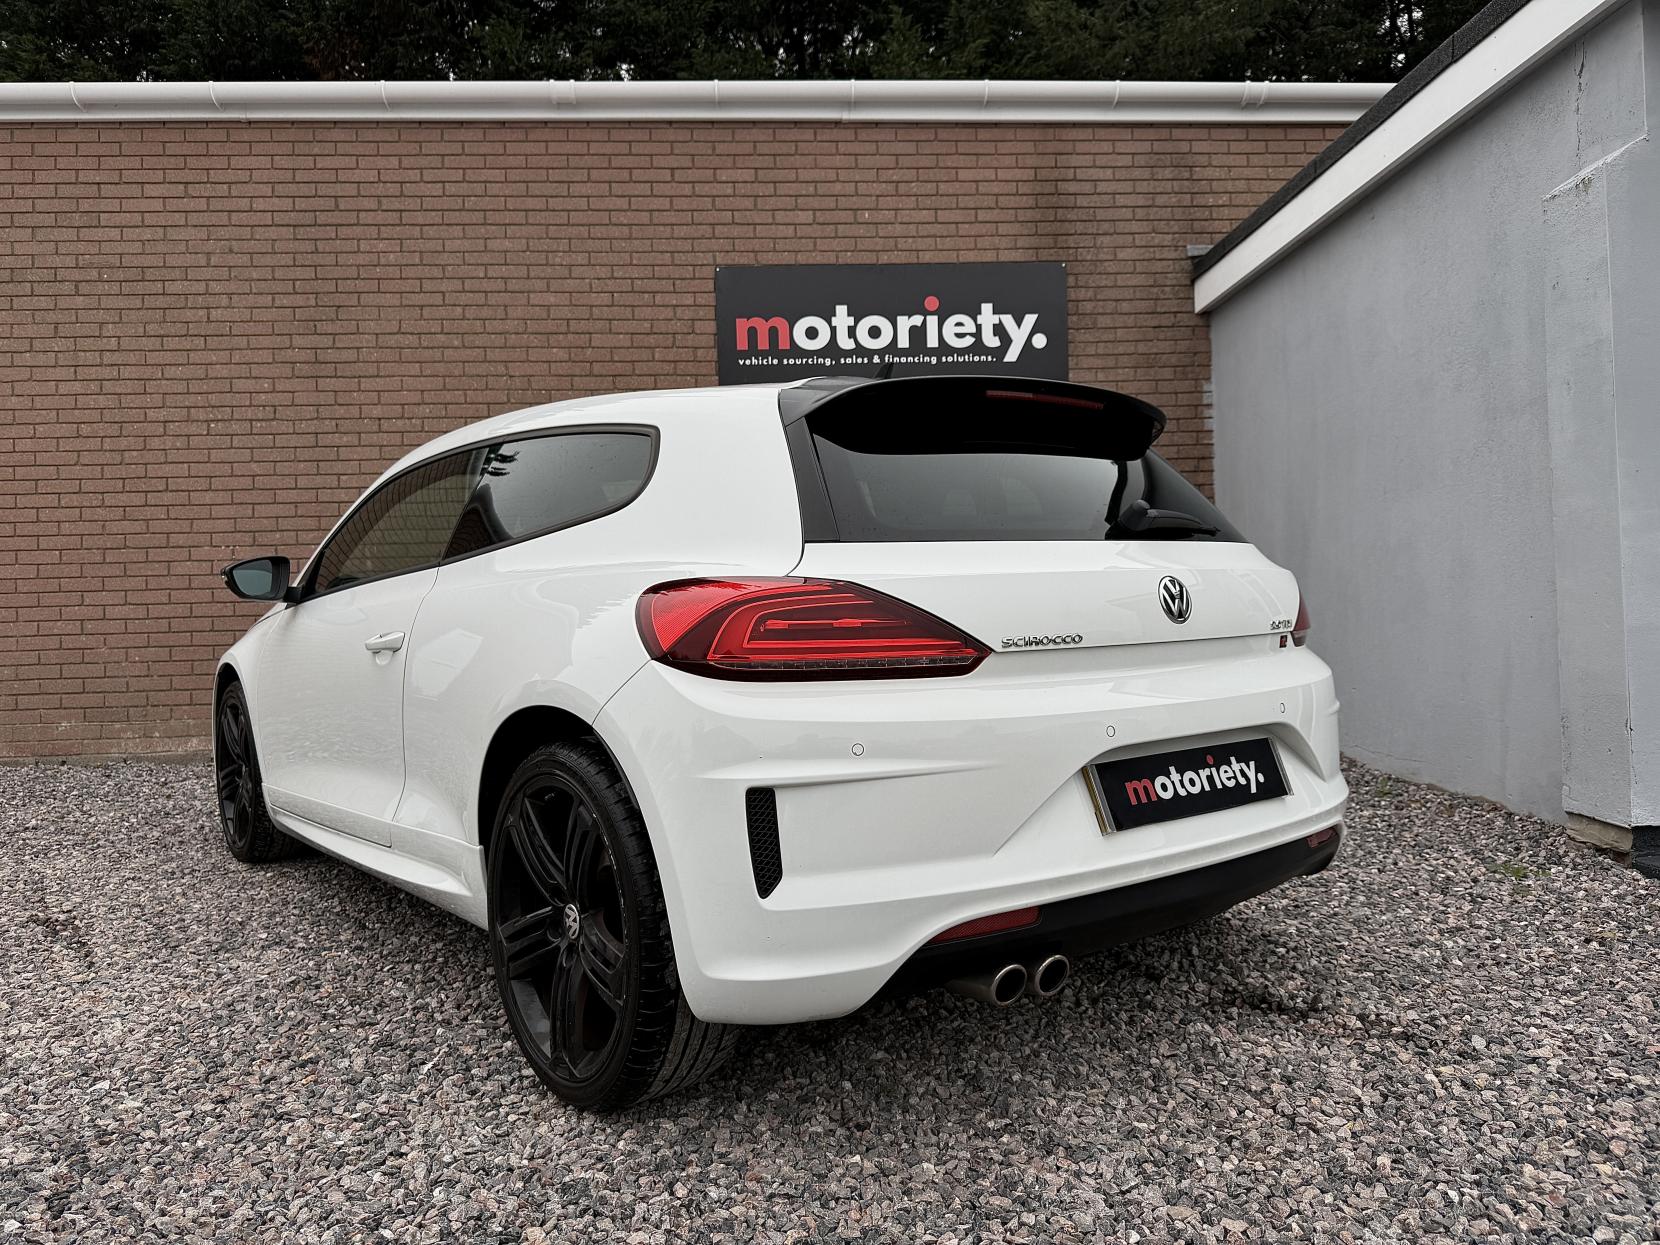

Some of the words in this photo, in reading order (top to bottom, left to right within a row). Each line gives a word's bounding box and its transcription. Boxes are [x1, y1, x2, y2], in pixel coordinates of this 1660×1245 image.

[735, 296, 1048, 362] motoriety.
[738, 356, 779, 366] vehicle
[783, 355, 836, 366] sourcing,
[840, 355, 869, 364] sales
[872, 354, 881, 364] &
[884, 354, 937, 365] financing
[941, 353, 997, 363] solutions.
[1001, 633, 1083, 649] SCIROCCO
[1125, 754, 1265, 806] motoriety.
